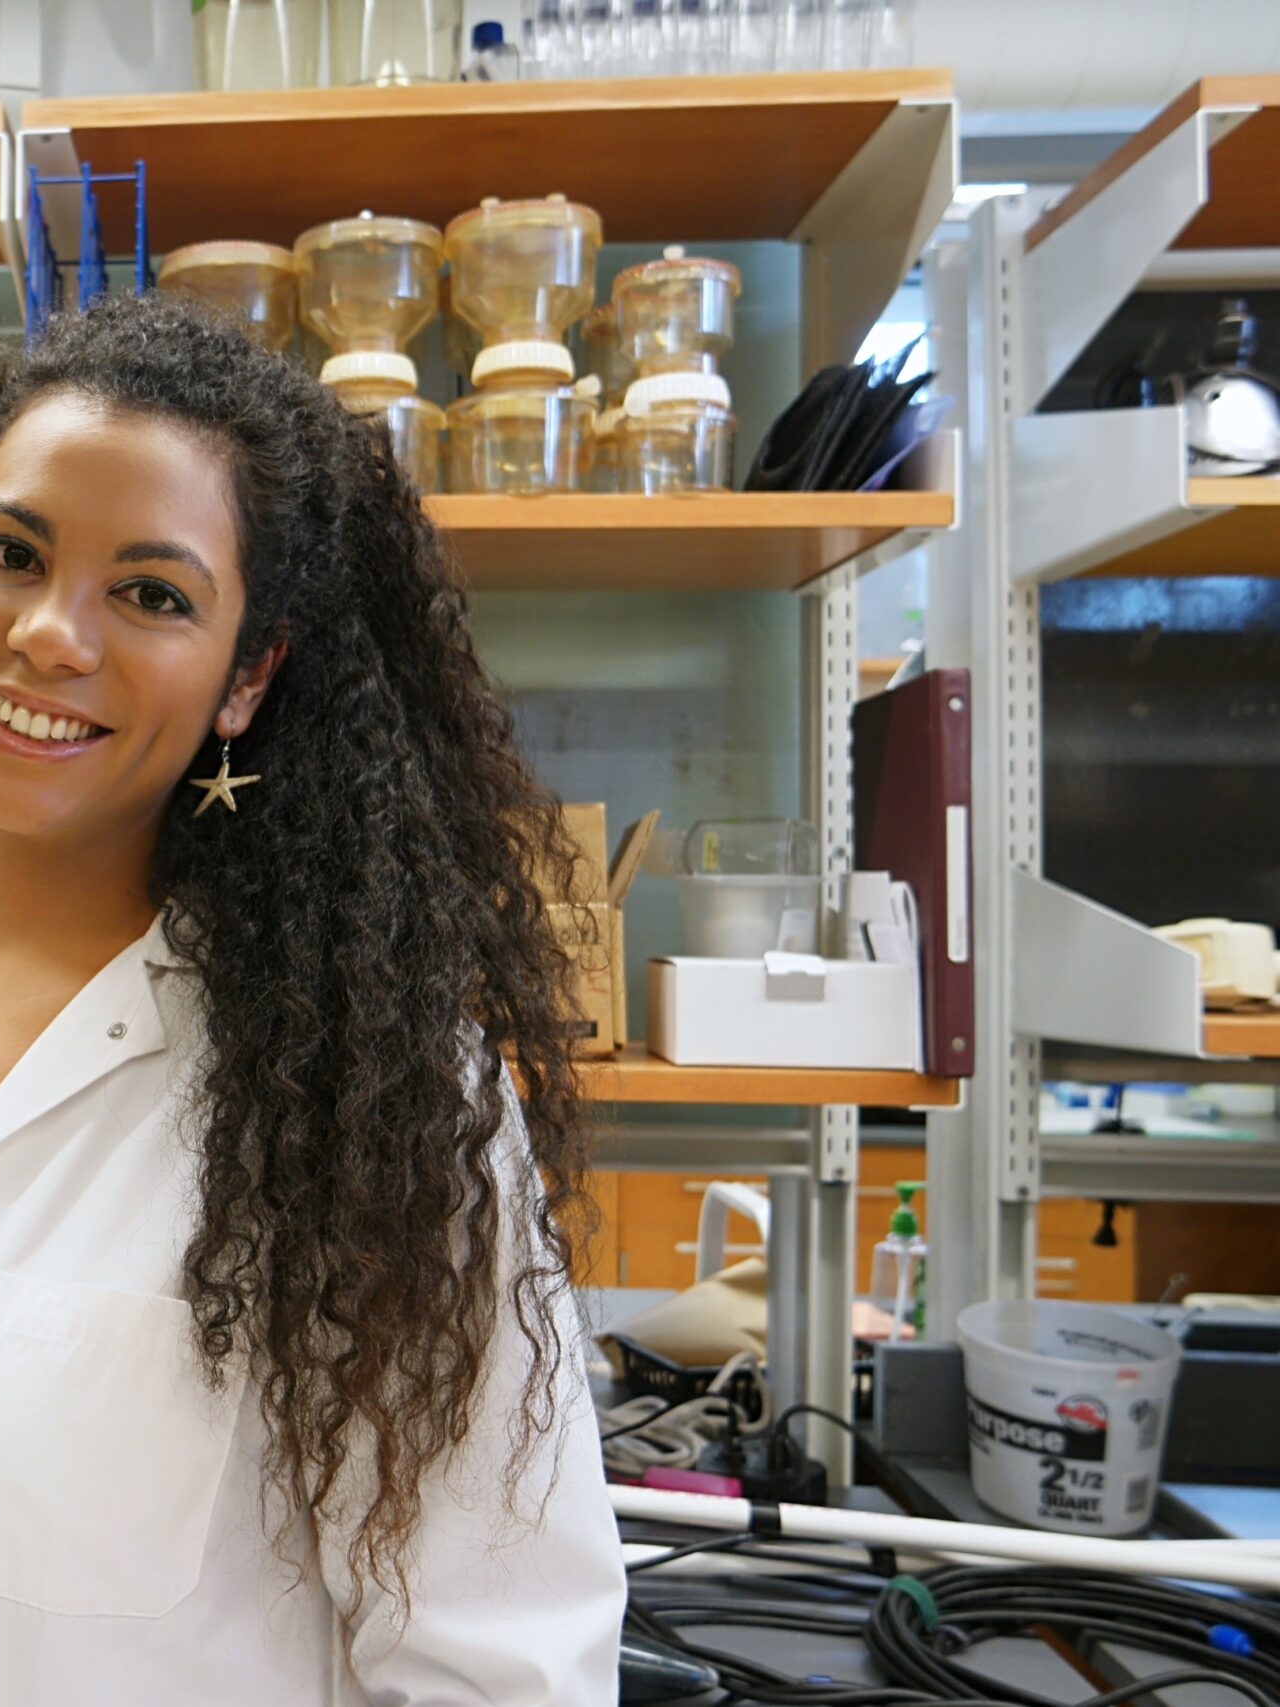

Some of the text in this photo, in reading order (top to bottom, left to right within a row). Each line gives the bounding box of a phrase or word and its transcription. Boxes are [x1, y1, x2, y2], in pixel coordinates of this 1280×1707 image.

[1039, 1457, 1104, 1491] 2 1/2
[1041, 1489, 1101, 1512] QUART
